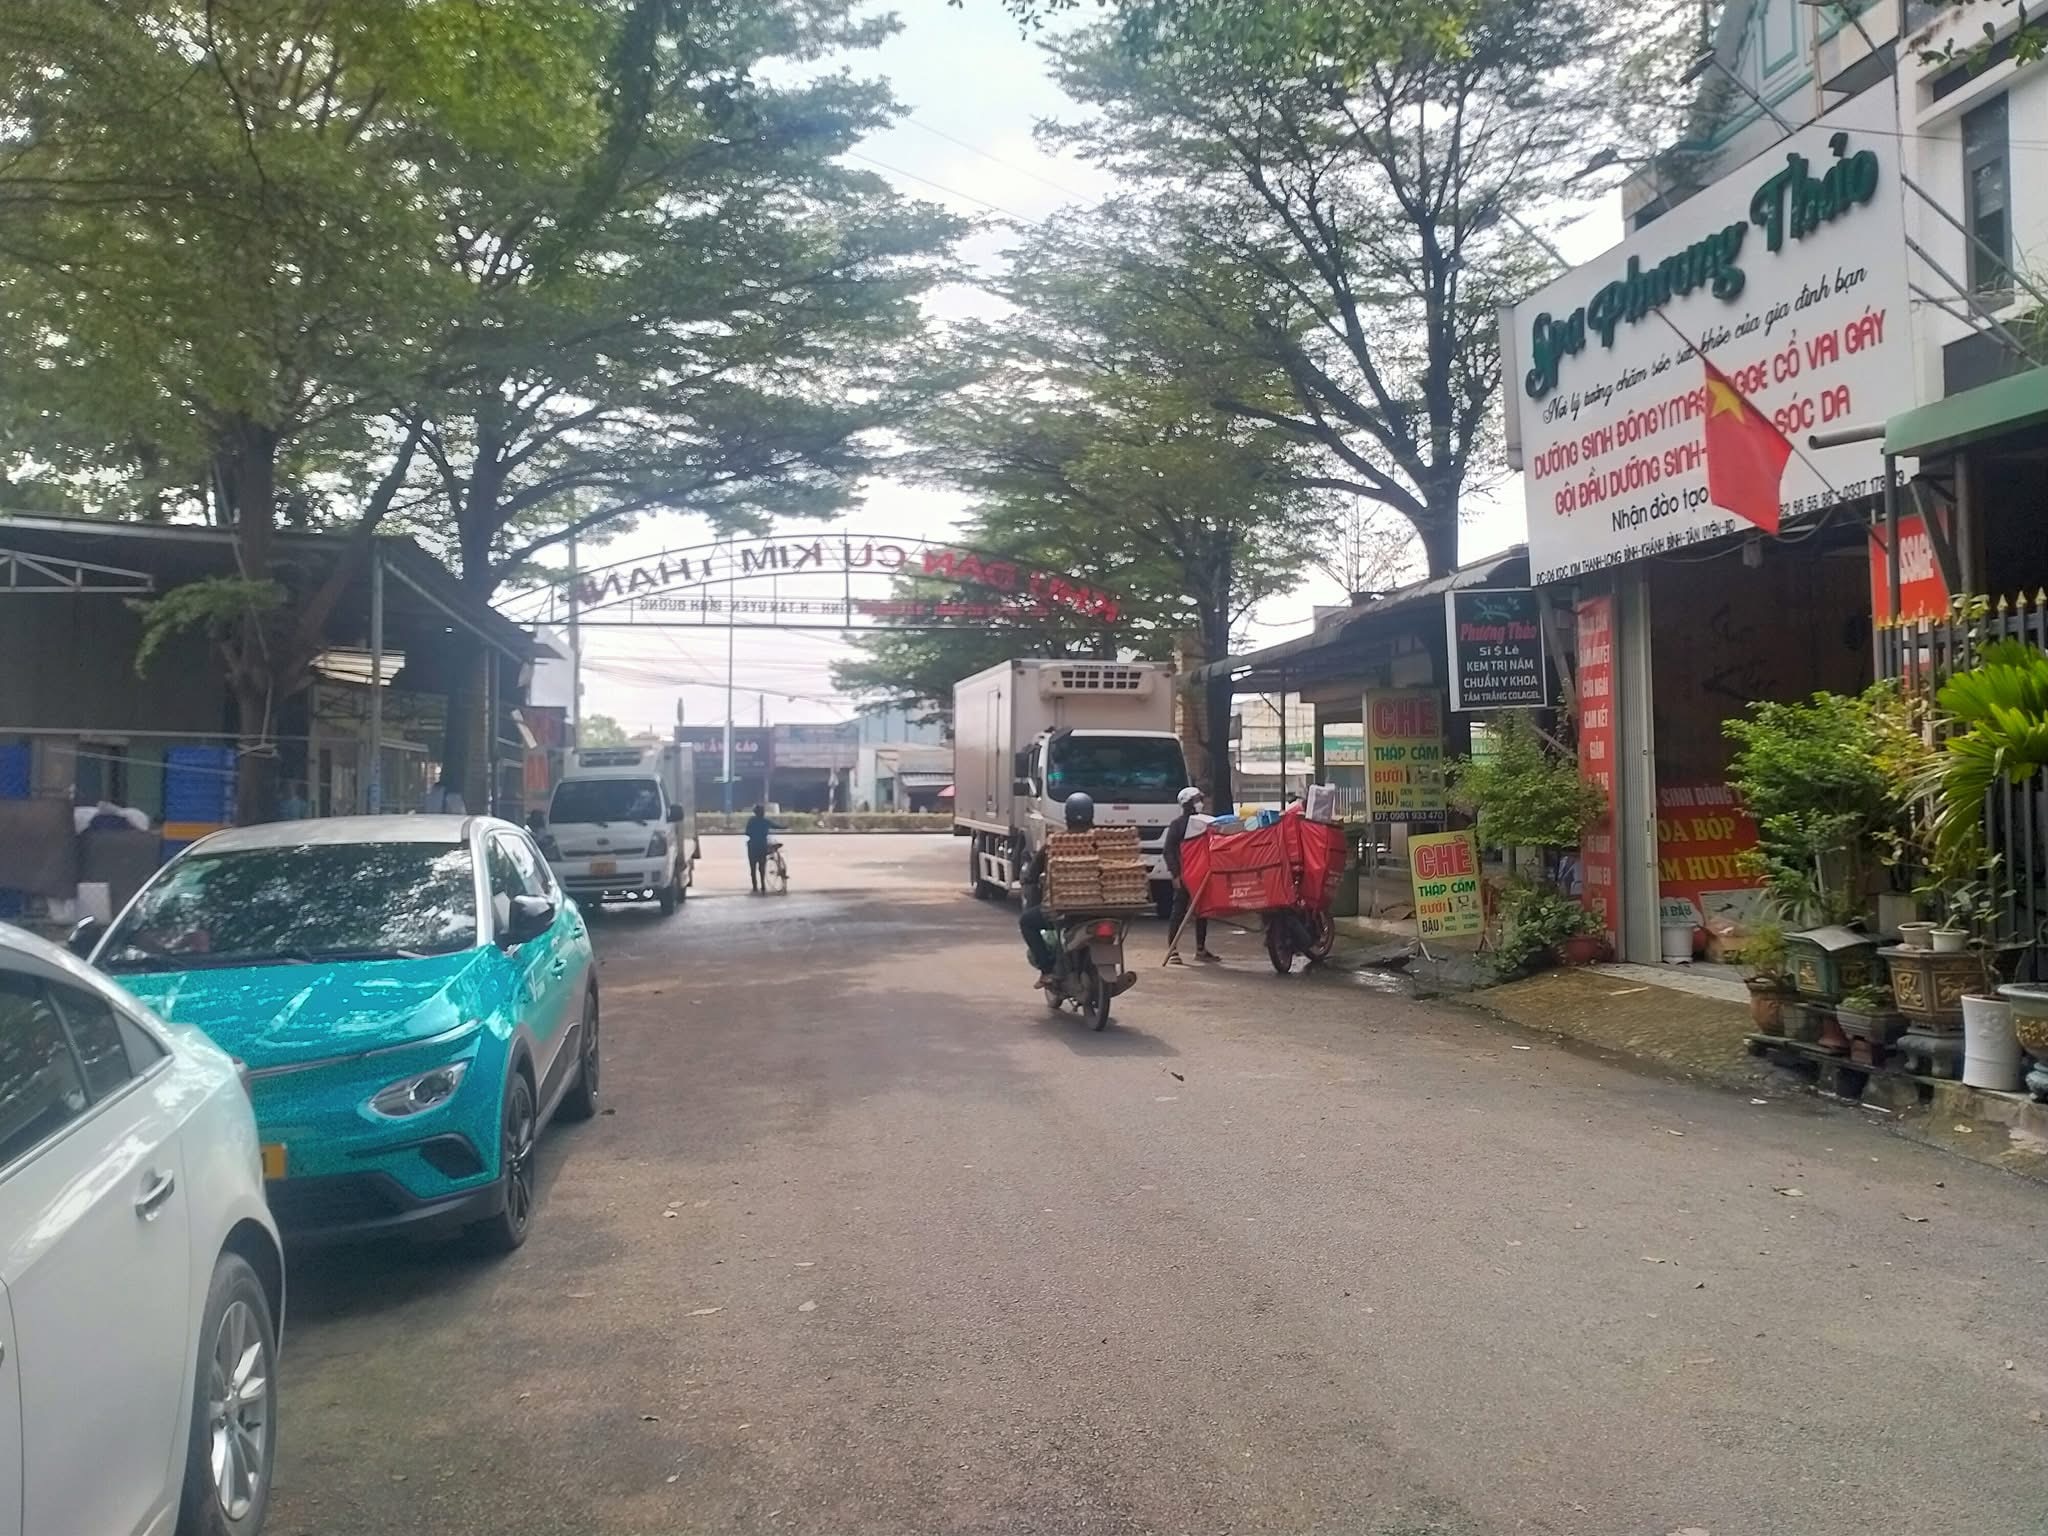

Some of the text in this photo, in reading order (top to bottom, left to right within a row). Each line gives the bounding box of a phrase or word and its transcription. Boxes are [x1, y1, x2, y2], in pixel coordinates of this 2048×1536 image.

[1750, 131, 1880, 253] Thảo
[1765, 302, 1790, 337] gia
[1794, 273, 1831, 312] đình
[1834, 266, 1869, 295] bạn
[1533, 441, 1579, 481] DƯỠNG
[1581, 424, 1614, 462] SINH
[1774, 329, 1801, 384] CỔ
[1806, 329, 1840, 371] VAI
[1845, 304, 1888, 355] GÁY
[1555, 481, 1577, 518] GỘI
[1579, 466, 1608, 506] ĐẦU
[1609, 455, 1661, 499] DƯỠNG
[1774, 391, 1815, 435] SÓC
[1821, 384, 1852, 423] DA
[1611, 485, 1709, 533] Nhận đào tạo
[1466, 661, 1489, 672] KEM
[1491, 659, 1508, 673] TRỊ
[1500, 676, 1509, 687] Y
[1510, 675, 1538, 687] KHOA
[1375, 787, 1394, 809] ĐẬU
[1692, 811, 1736, 842] BÓP
[1415, 834, 1475, 880] CHÈ
[1418, 882, 1447, 898] THẬP
[1422, 916, 1440, 935] ĐẬU
